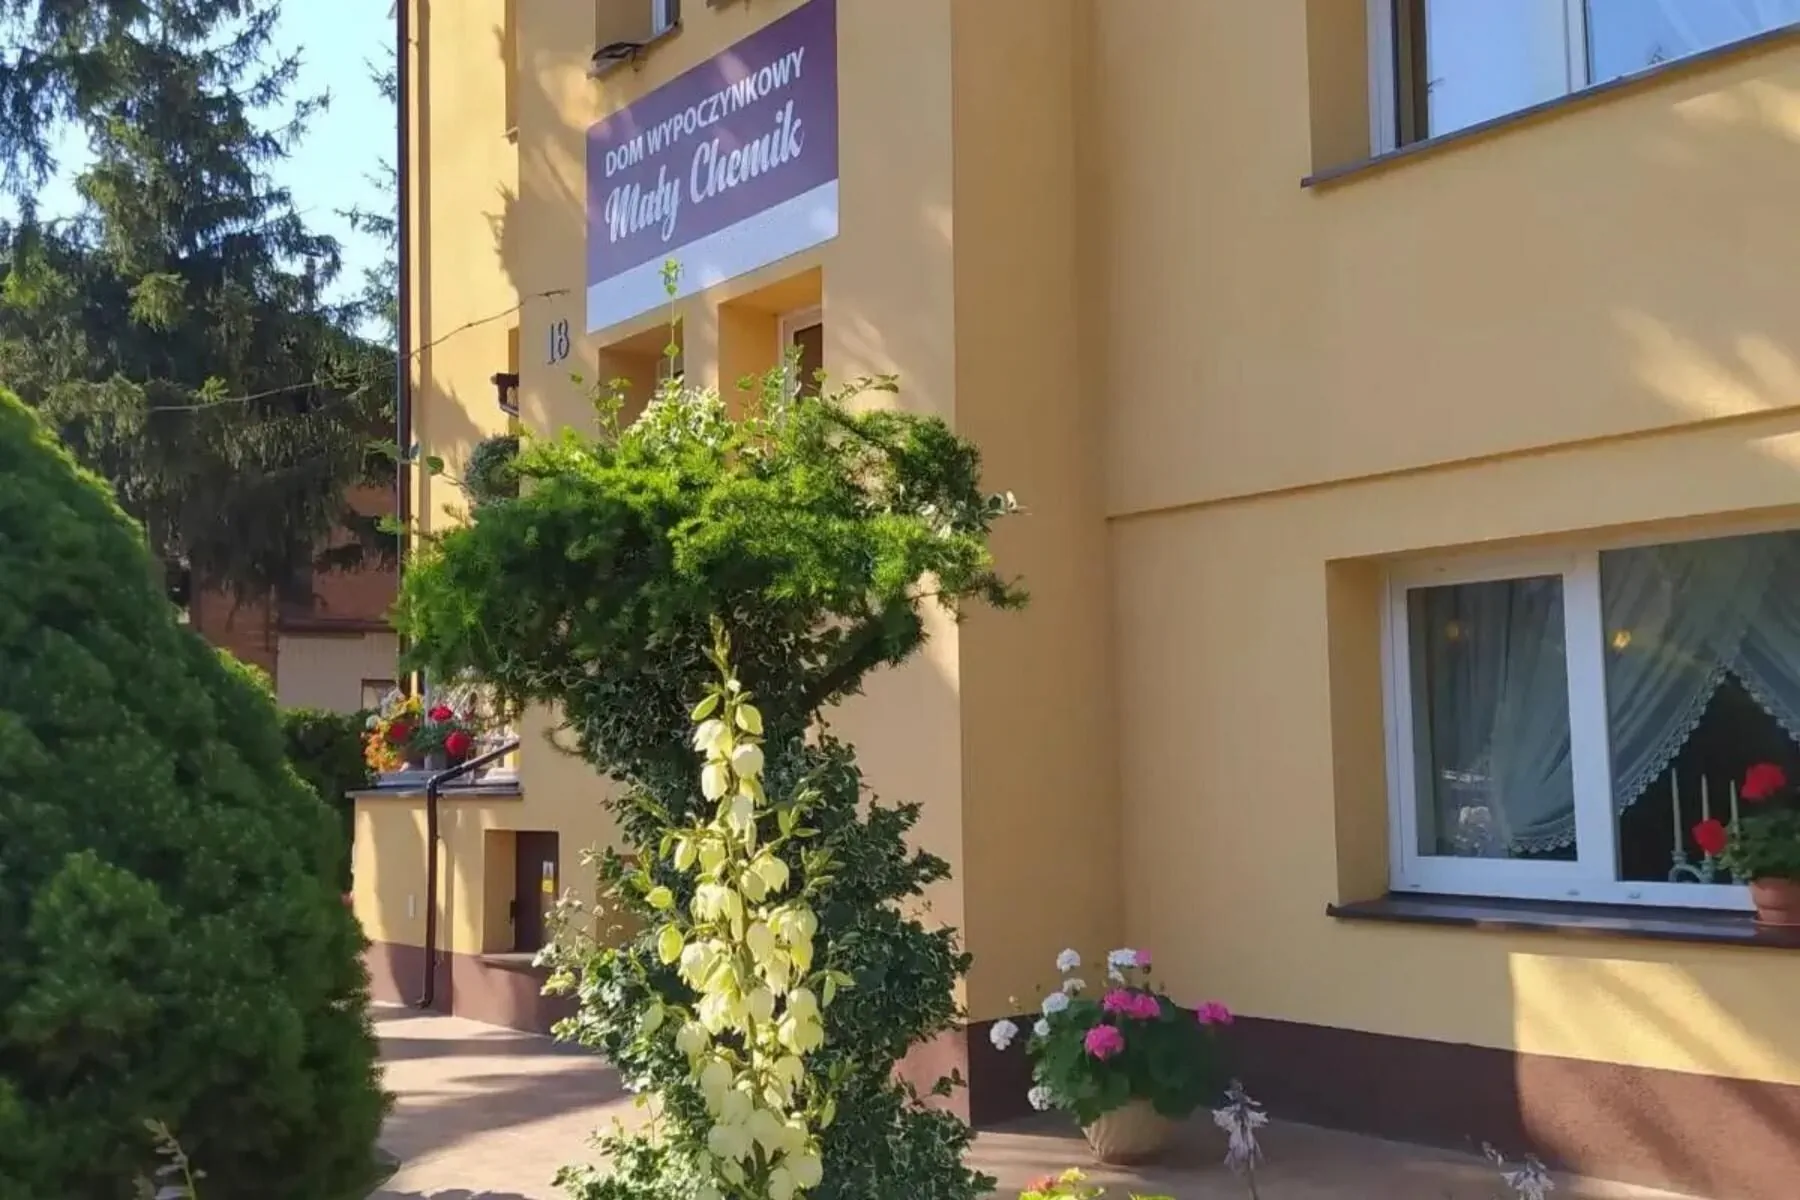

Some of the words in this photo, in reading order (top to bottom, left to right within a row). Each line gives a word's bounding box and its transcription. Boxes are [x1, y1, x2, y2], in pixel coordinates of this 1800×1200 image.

[605, 136, 643, 178] DOM
[647, 46, 805, 155] WYPOCZYNKOWY
[689, 99, 805, 204] Chemik
[546, 317, 570, 365] 18
